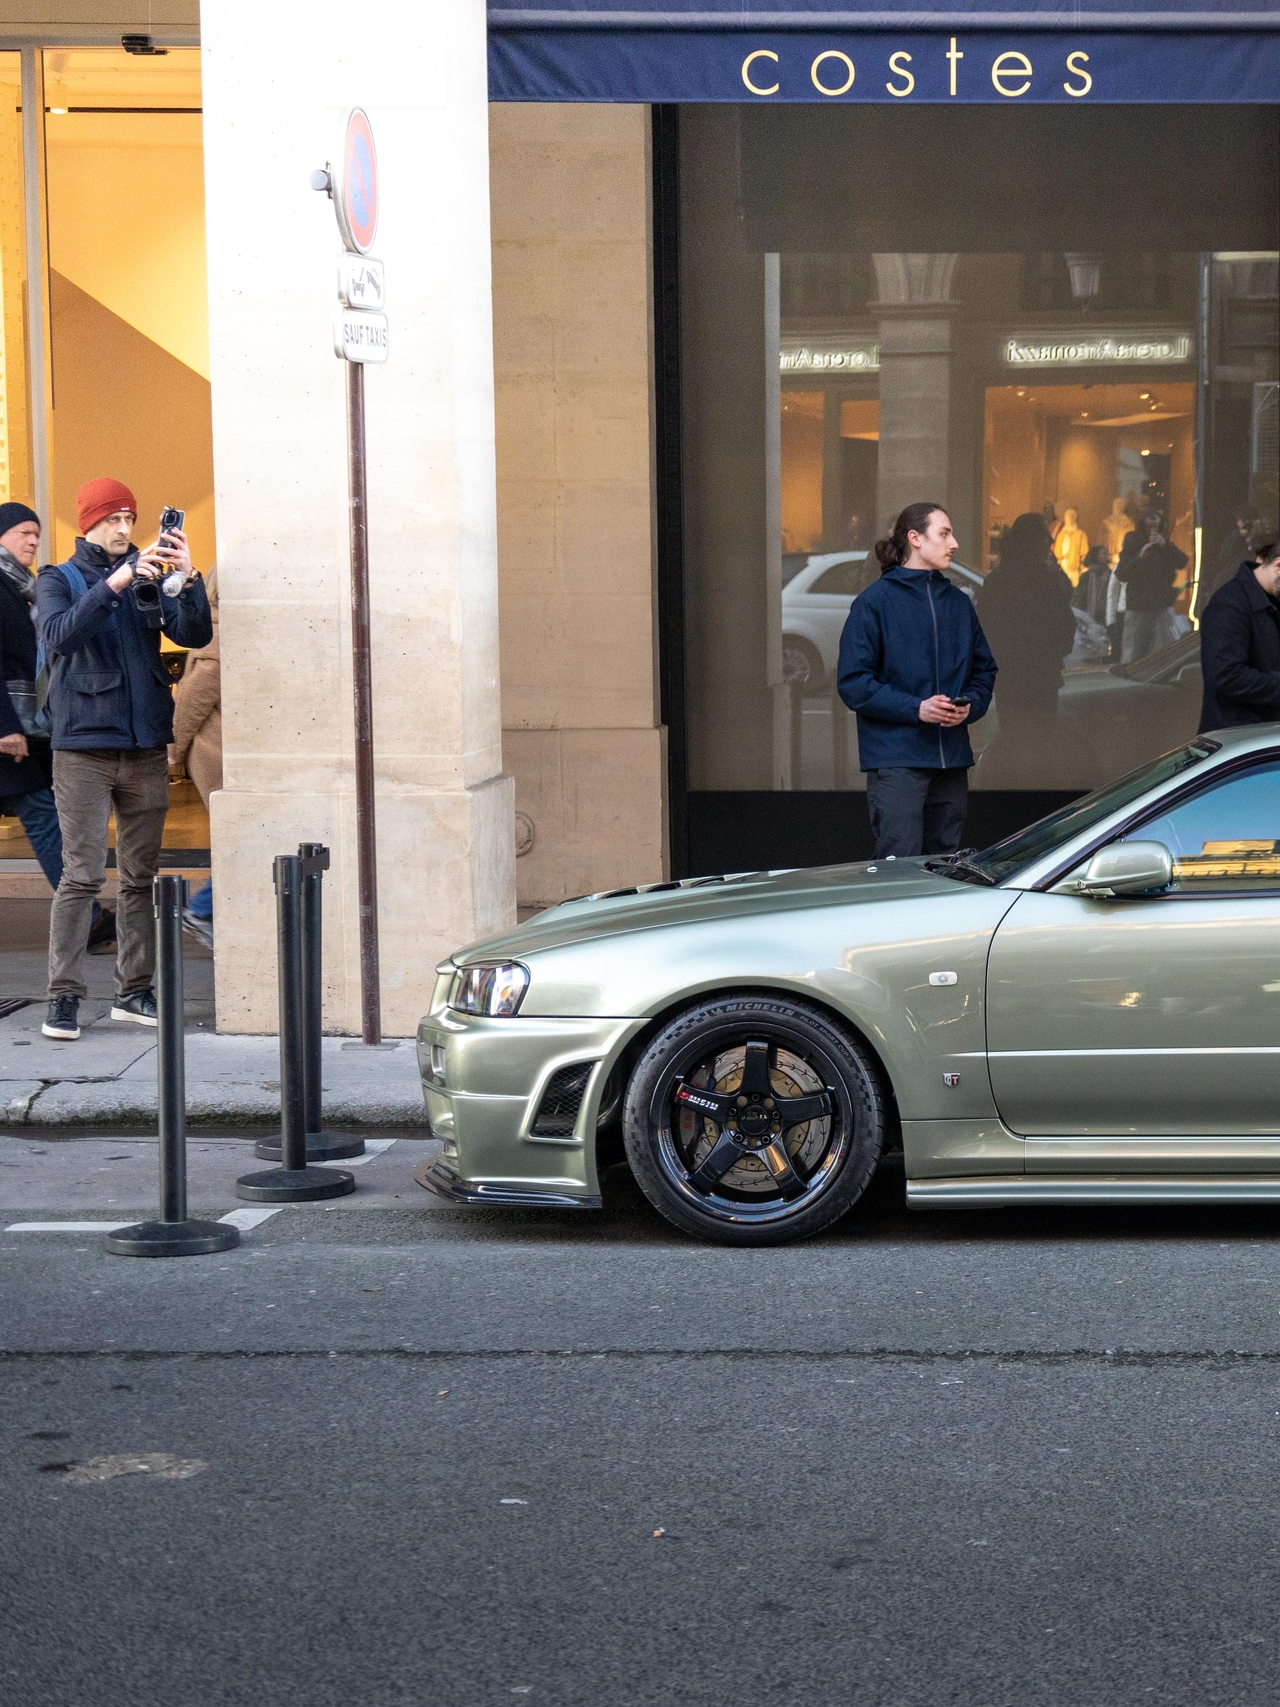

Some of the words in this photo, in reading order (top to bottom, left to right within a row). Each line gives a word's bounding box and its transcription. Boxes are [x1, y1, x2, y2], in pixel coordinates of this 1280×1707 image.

[741, 37, 1093, 97] costes
[344, 323, 363, 345] SAUF
[365, 326, 387, 348] TAXIS
[726, 1002, 796, 1017] MICHELIN
